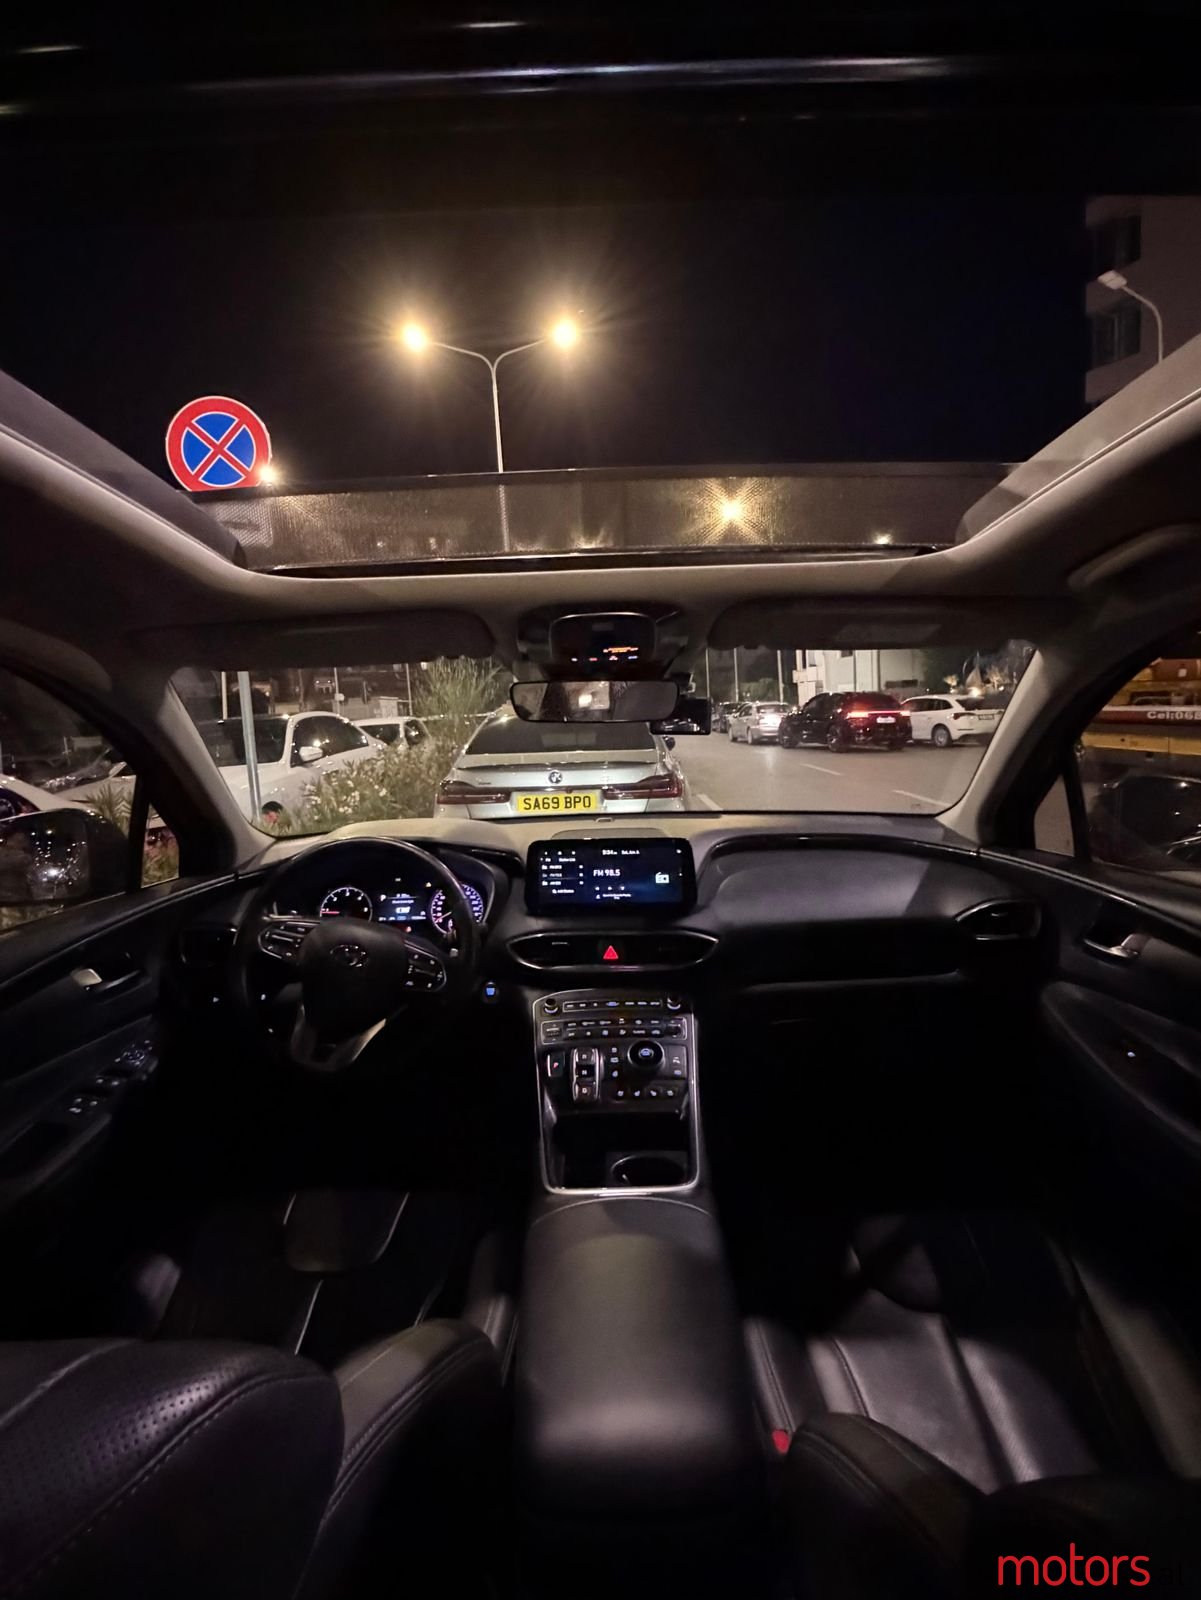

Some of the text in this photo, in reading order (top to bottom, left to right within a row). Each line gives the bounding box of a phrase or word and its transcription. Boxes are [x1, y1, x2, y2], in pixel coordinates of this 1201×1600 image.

[523, 795, 591, 811] SA69 BPO
[593, 868, 621, 877] FM 98.5
